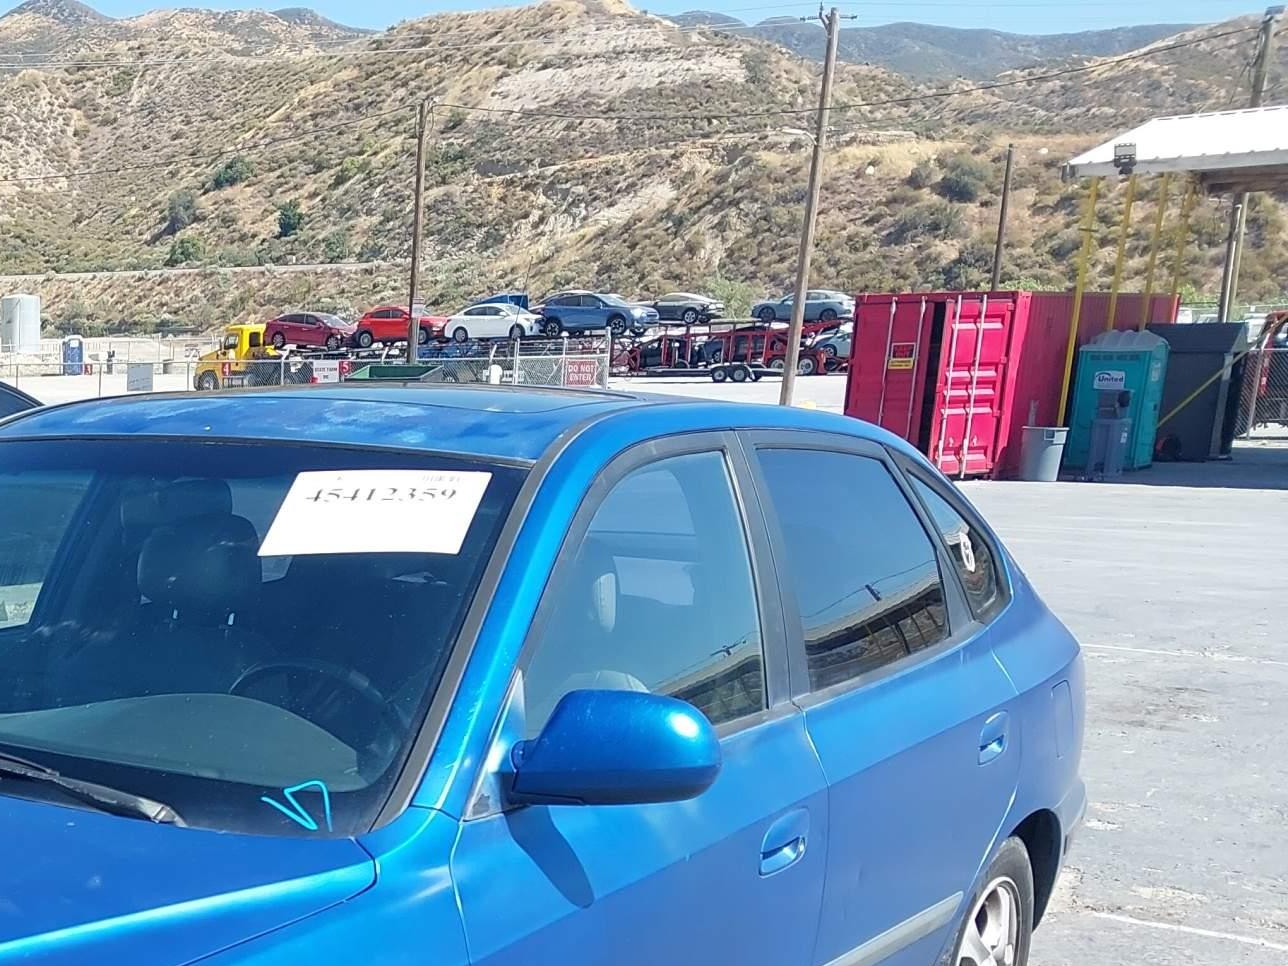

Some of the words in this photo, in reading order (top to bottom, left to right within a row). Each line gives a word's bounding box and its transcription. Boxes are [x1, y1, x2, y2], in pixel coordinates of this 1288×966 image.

[223, 362, 229, 376] 4
[342, 361, 349, 372] 5
[568, 365, 578, 373] DO
[580, 364, 594, 373] NOT
[569, 373, 592, 381] ENTER
[1098, 375, 1124, 383] United
[305, 487, 457, 502] 45412359
